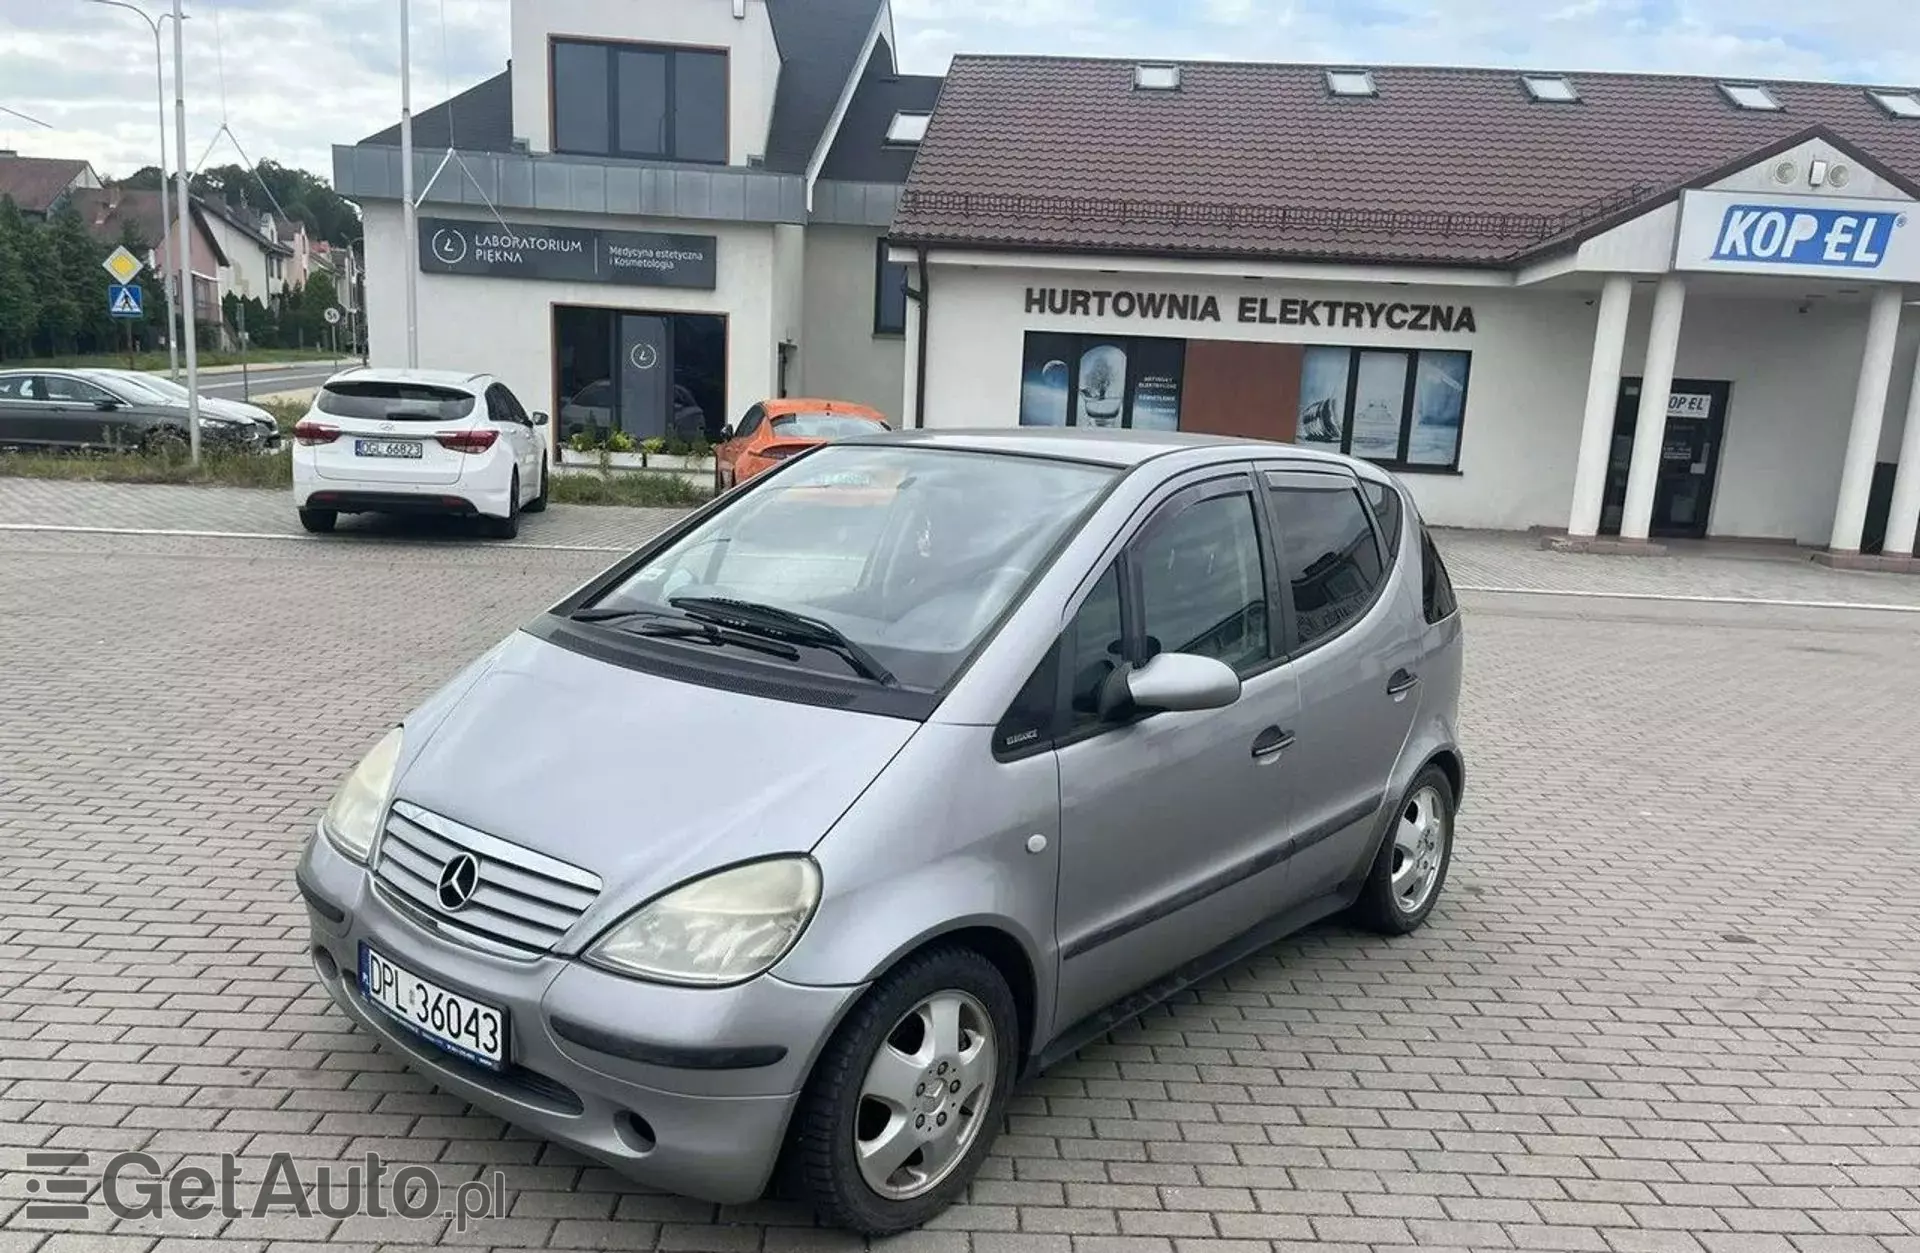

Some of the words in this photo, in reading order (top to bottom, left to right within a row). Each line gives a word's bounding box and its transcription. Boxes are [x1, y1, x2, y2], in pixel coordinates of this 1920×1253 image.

[475, 234, 582, 252] LABORATORIUM
[475, 248, 523, 264] PIĘKNA
[609, 246, 654, 259] Medycyna
[655, 249, 703, 262] estetyczna
[1024, 287, 1221, 322] HURTOWNIA
[1237, 296, 1477, 333] ELEKTRYCZNA
[371, 955, 408, 1014] DPL
[416, 982, 499, 1054] 36043
